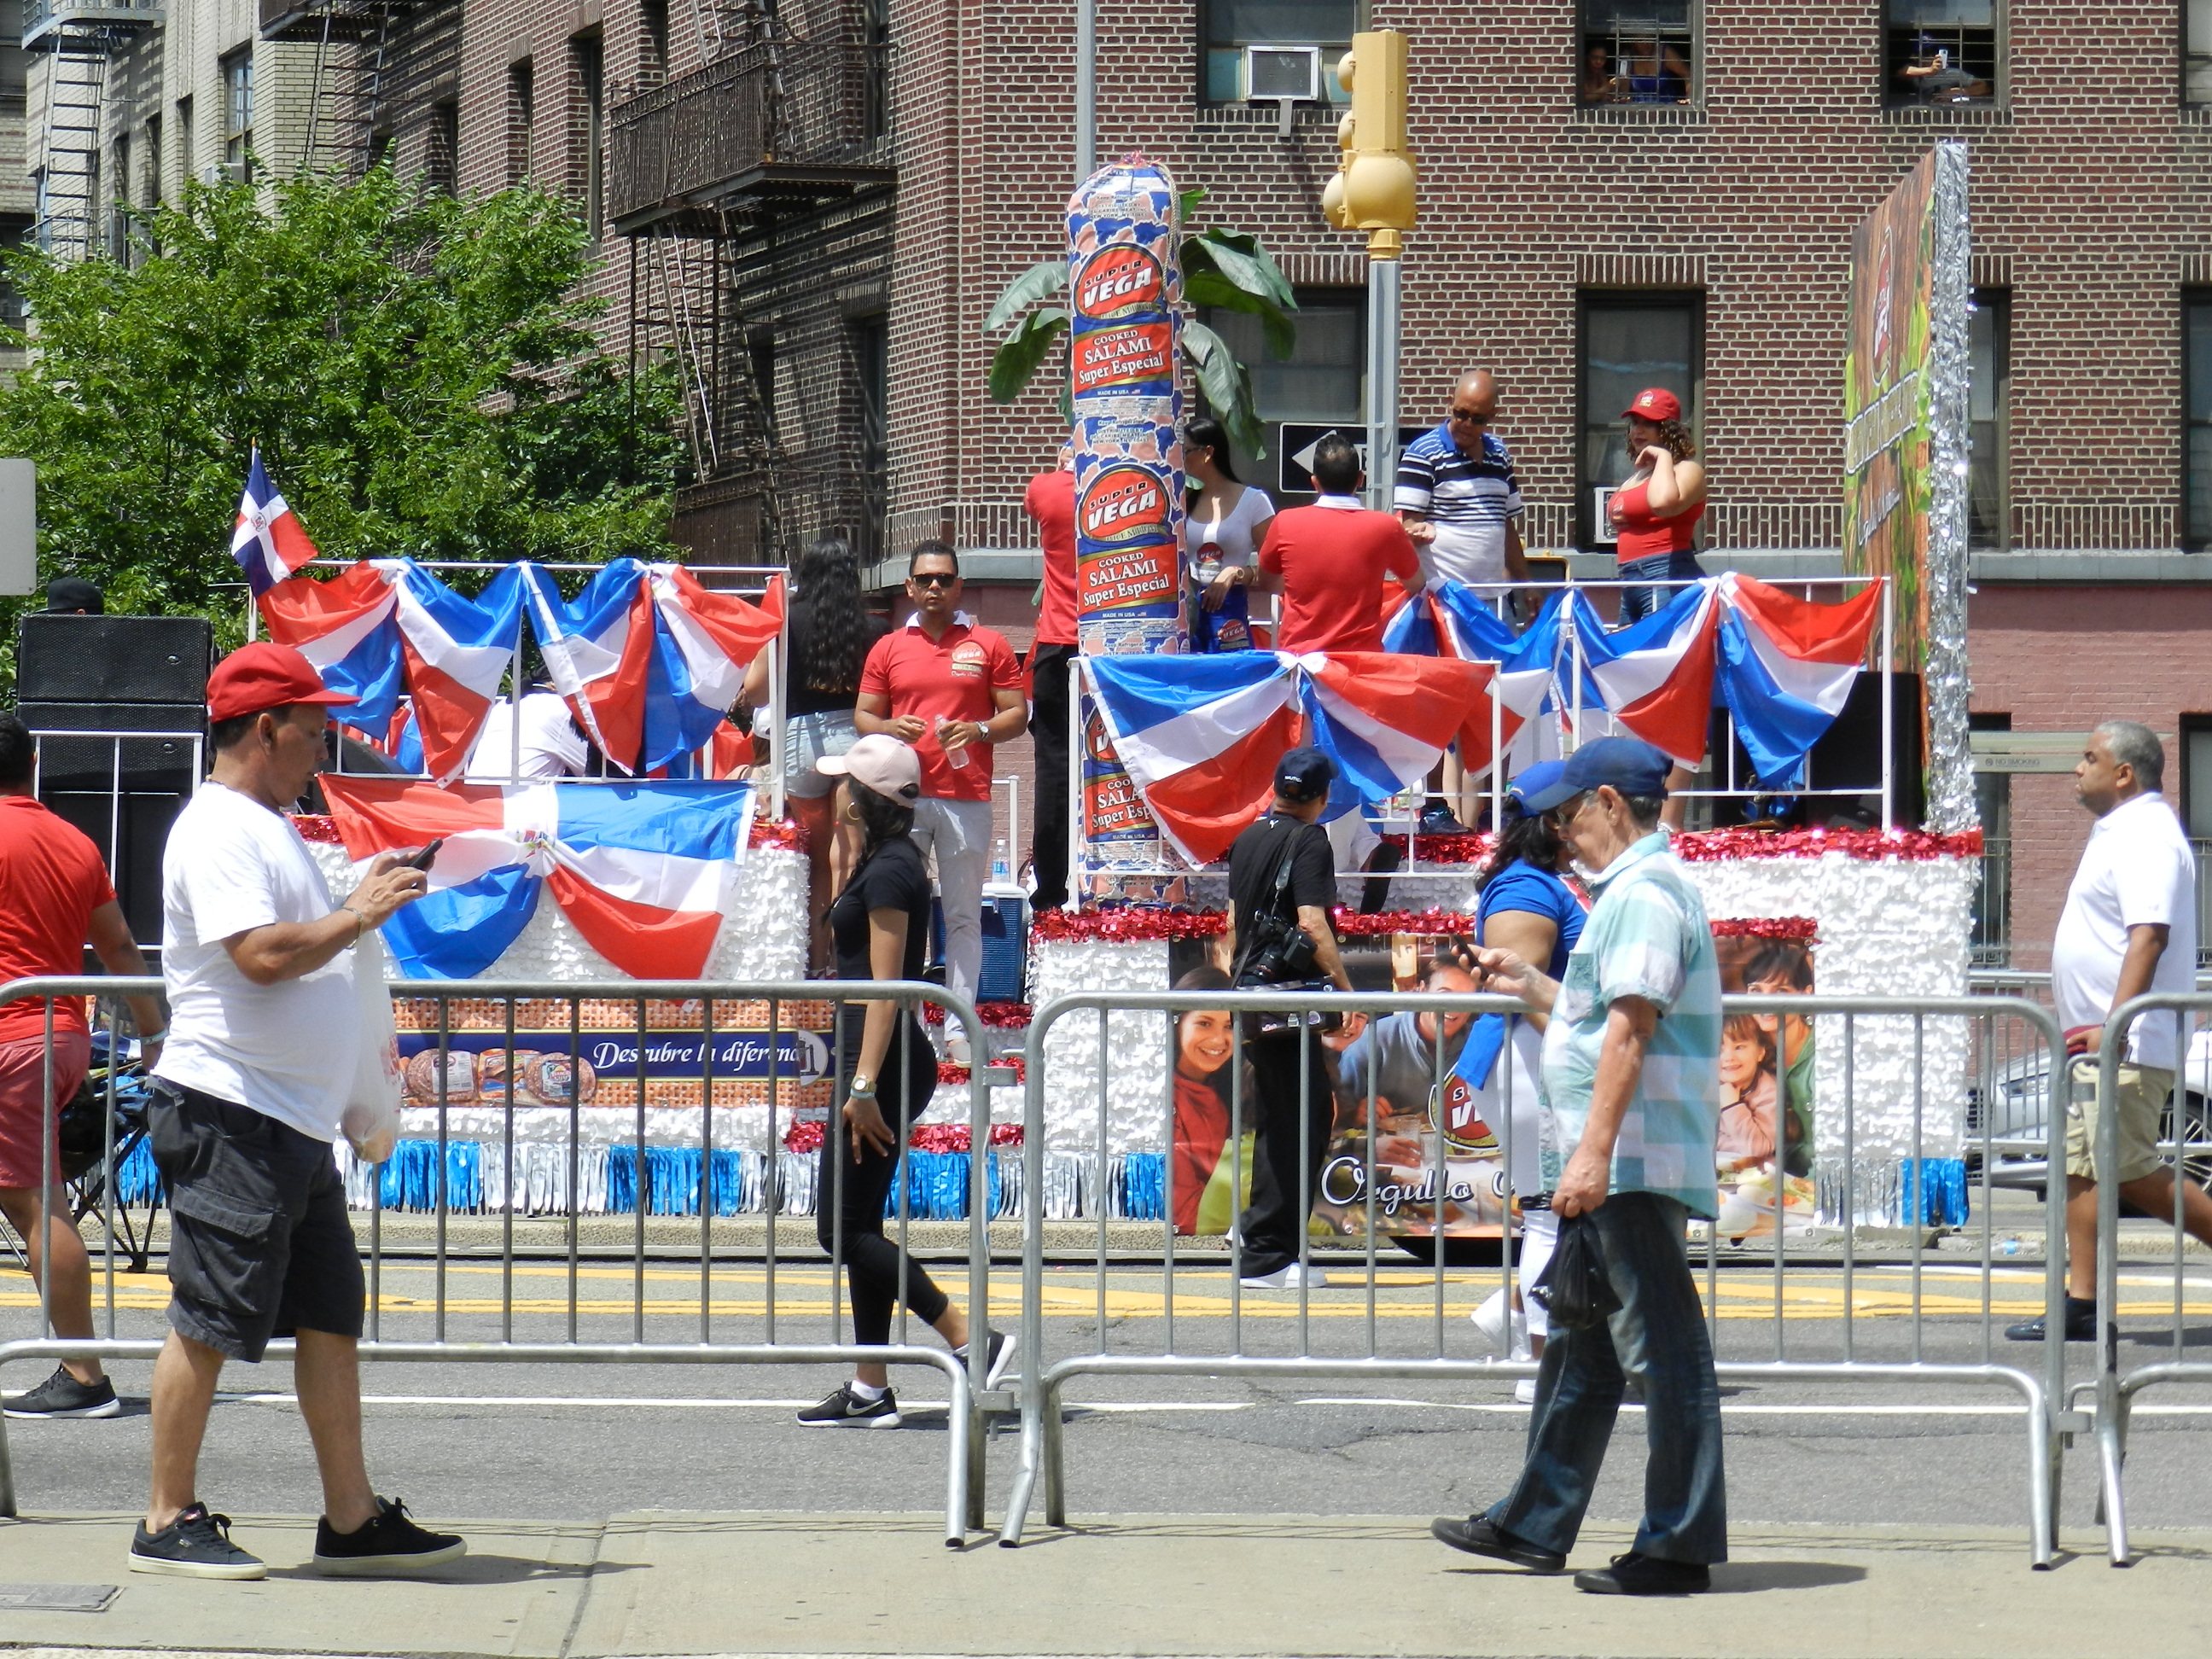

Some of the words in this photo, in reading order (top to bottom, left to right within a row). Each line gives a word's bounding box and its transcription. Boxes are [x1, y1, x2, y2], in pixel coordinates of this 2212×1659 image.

[1085, 259, 1143, 288] SUPER
[1084, 266, 1152, 309] VEGA
[1085, 337, 1153, 364] SALAMI
[1094, 329, 1138, 346] COOKED
[1079, 366, 1109, 385] Super
[1111, 352, 1164, 375] Especial
[1089, 481, 1147, 510] SUPER
[1087, 488, 1156, 532] VEGA
[1089, 559, 1158, 587] SALAMI
[1098, 552, 1144, 568] COOKED
[1084, 588, 1115, 607] Super
[1116, 573, 1169, 597] Especial
[1223, 626, 1244, 638] VEGA
[1107, 778, 1132, 789] COO
[1097, 787, 1142, 809] SALA
[1091, 810, 1124, 829] Super
